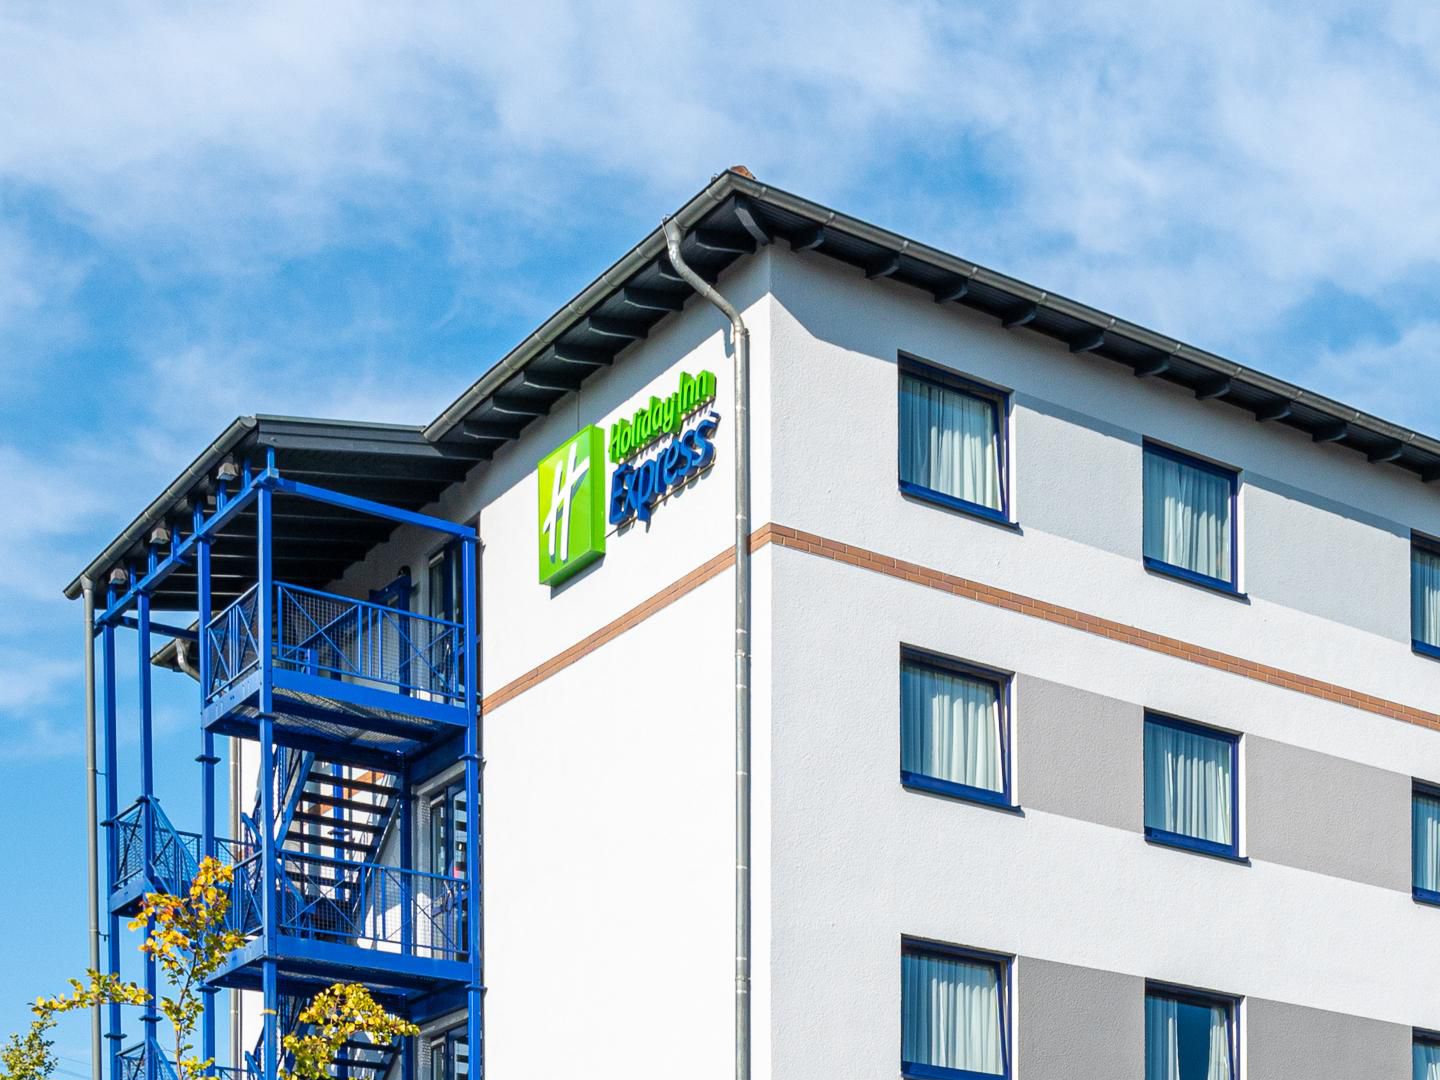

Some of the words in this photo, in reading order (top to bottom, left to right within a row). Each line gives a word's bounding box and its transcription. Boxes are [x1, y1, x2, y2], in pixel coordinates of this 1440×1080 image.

[608, 391, 682, 464] Holiday
[678, 370, 717, 413] Inn
[609, 417, 719, 525] Express
